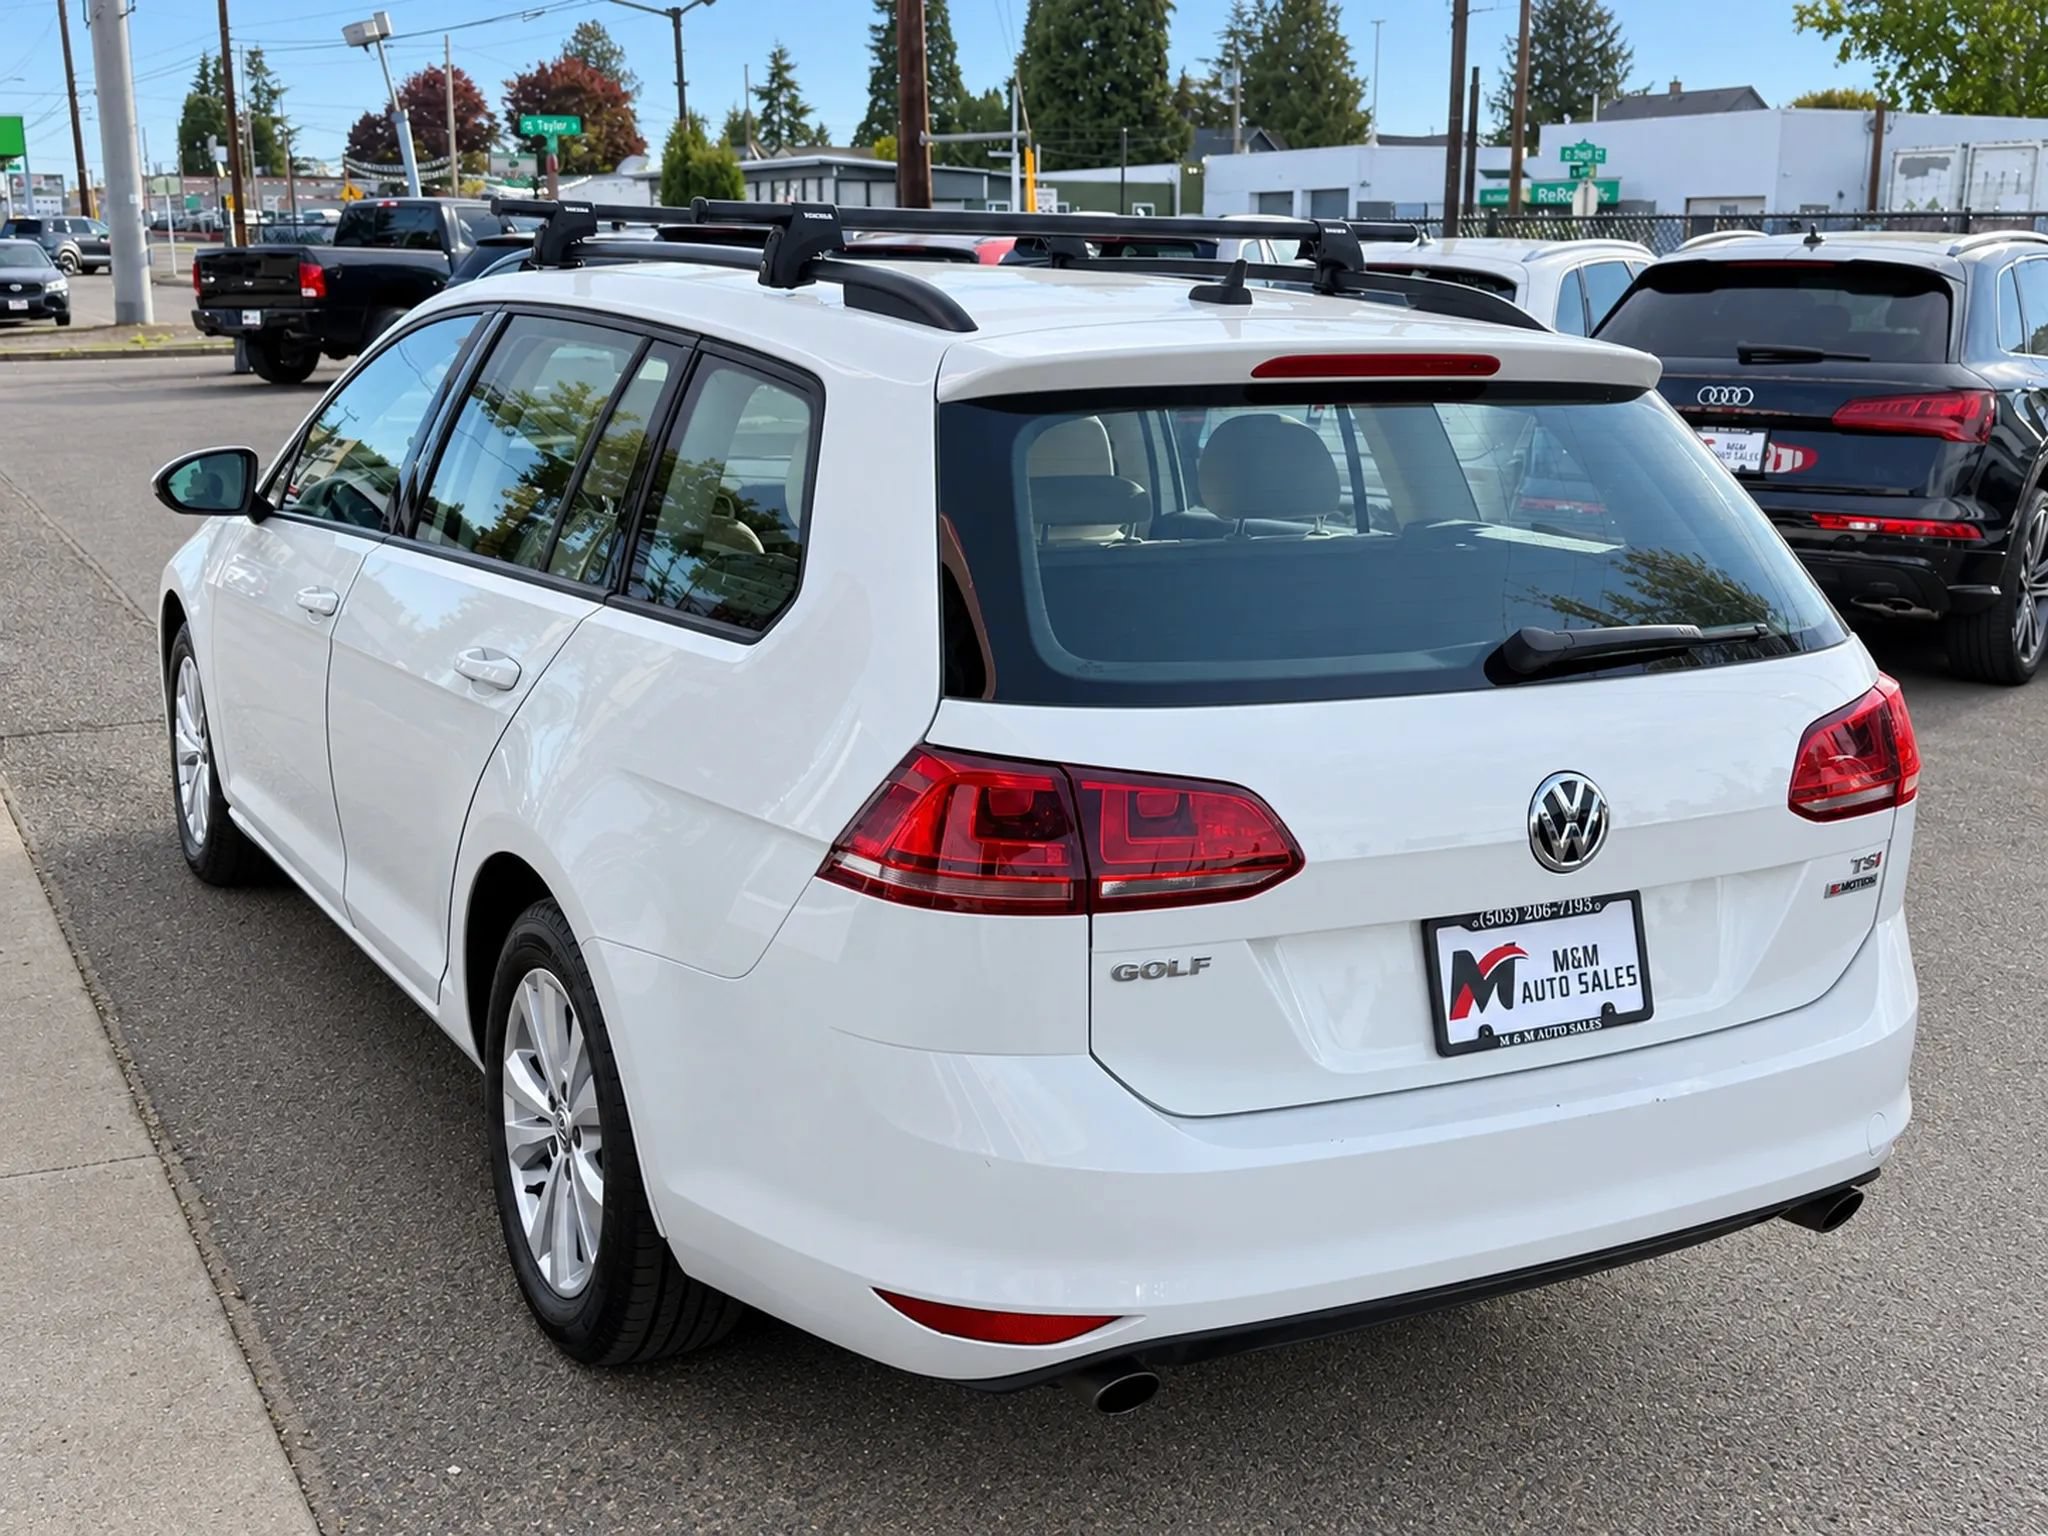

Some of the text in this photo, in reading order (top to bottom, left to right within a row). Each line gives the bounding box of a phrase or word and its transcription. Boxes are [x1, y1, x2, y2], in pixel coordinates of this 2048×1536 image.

[1480, 897, 1593, 928] (503) 206-7193
[1110, 956, 1212, 982] GOLF
[1552, 944, 1599, 973] M&M
[1522, 964, 1637, 1004] AUTO SALES
[1499, 1034, 1510, 1047] M
[1523, 1030, 1535, 1042] M
[1537, 1025, 1567, 1041] AUTO
[1569, 1018, 1602, 1034] SALES
